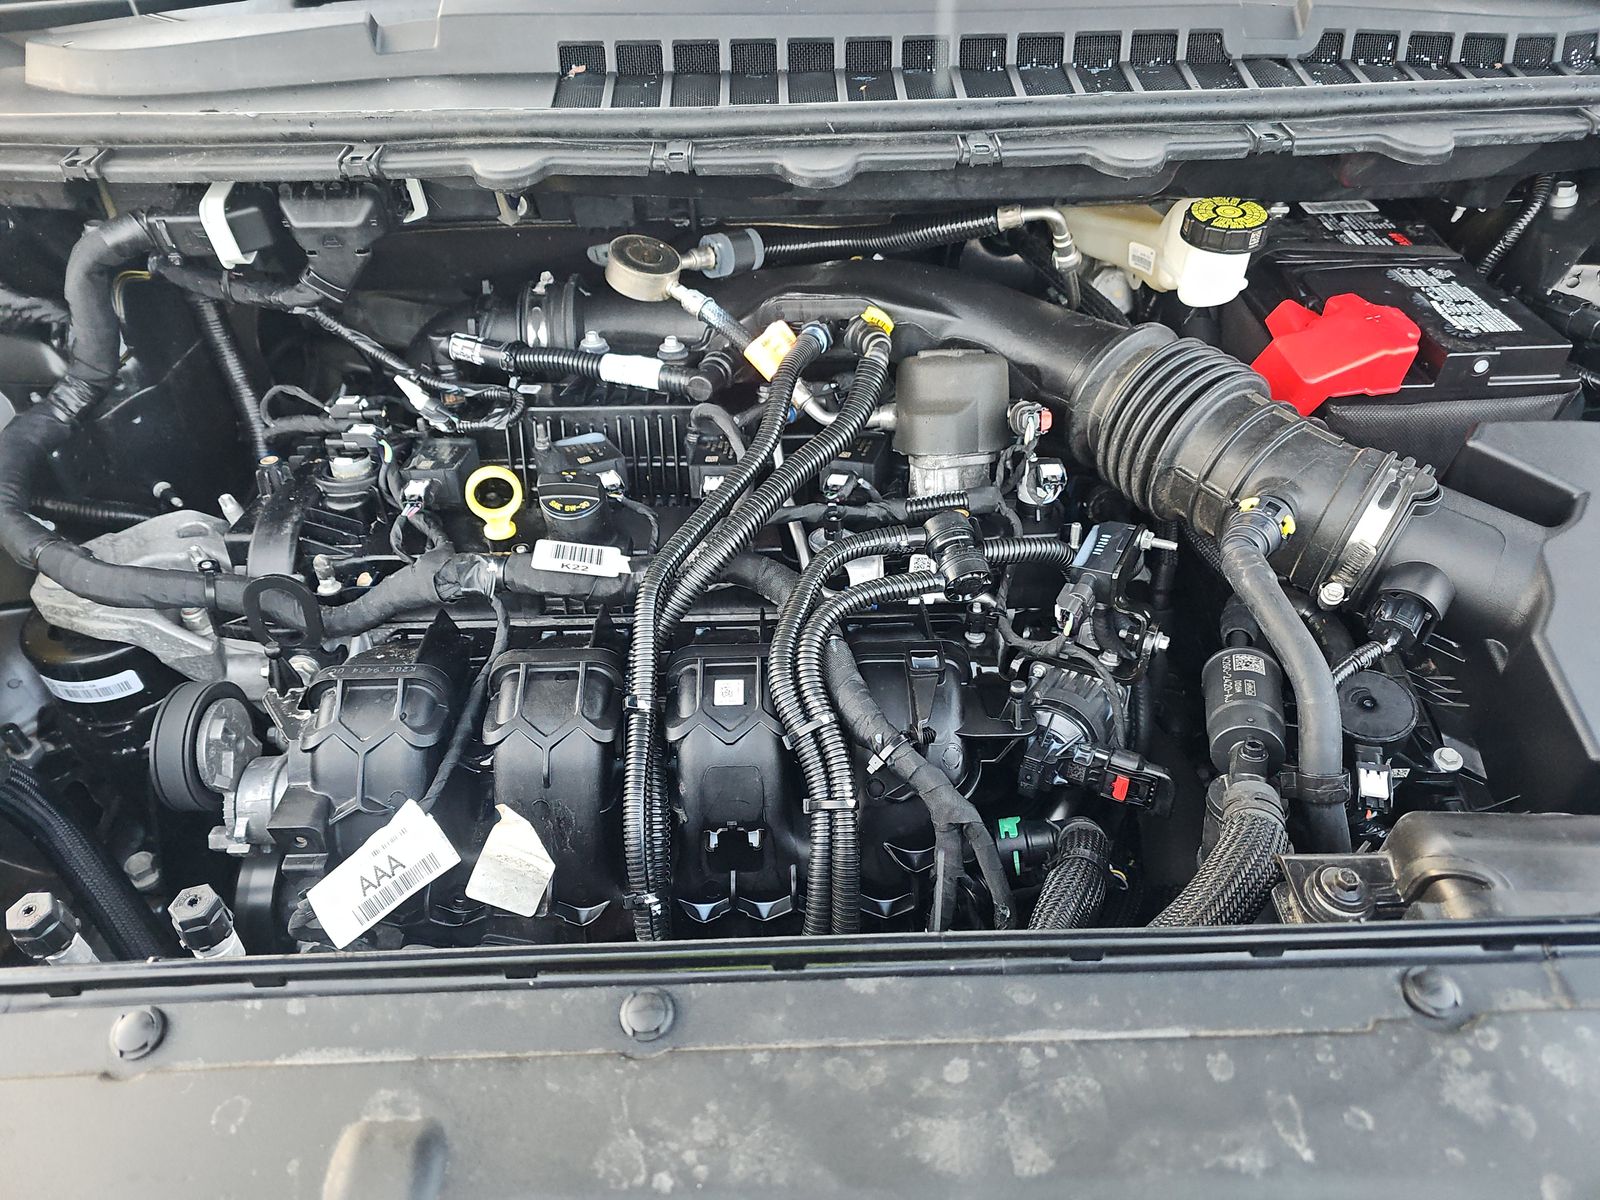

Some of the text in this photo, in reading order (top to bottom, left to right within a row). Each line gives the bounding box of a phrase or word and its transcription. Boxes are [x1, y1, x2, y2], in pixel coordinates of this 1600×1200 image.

[549, 500, 564, 511] SAE
[561, 563, 589, 572] K22
[360, 854, 406, 897] AAA
